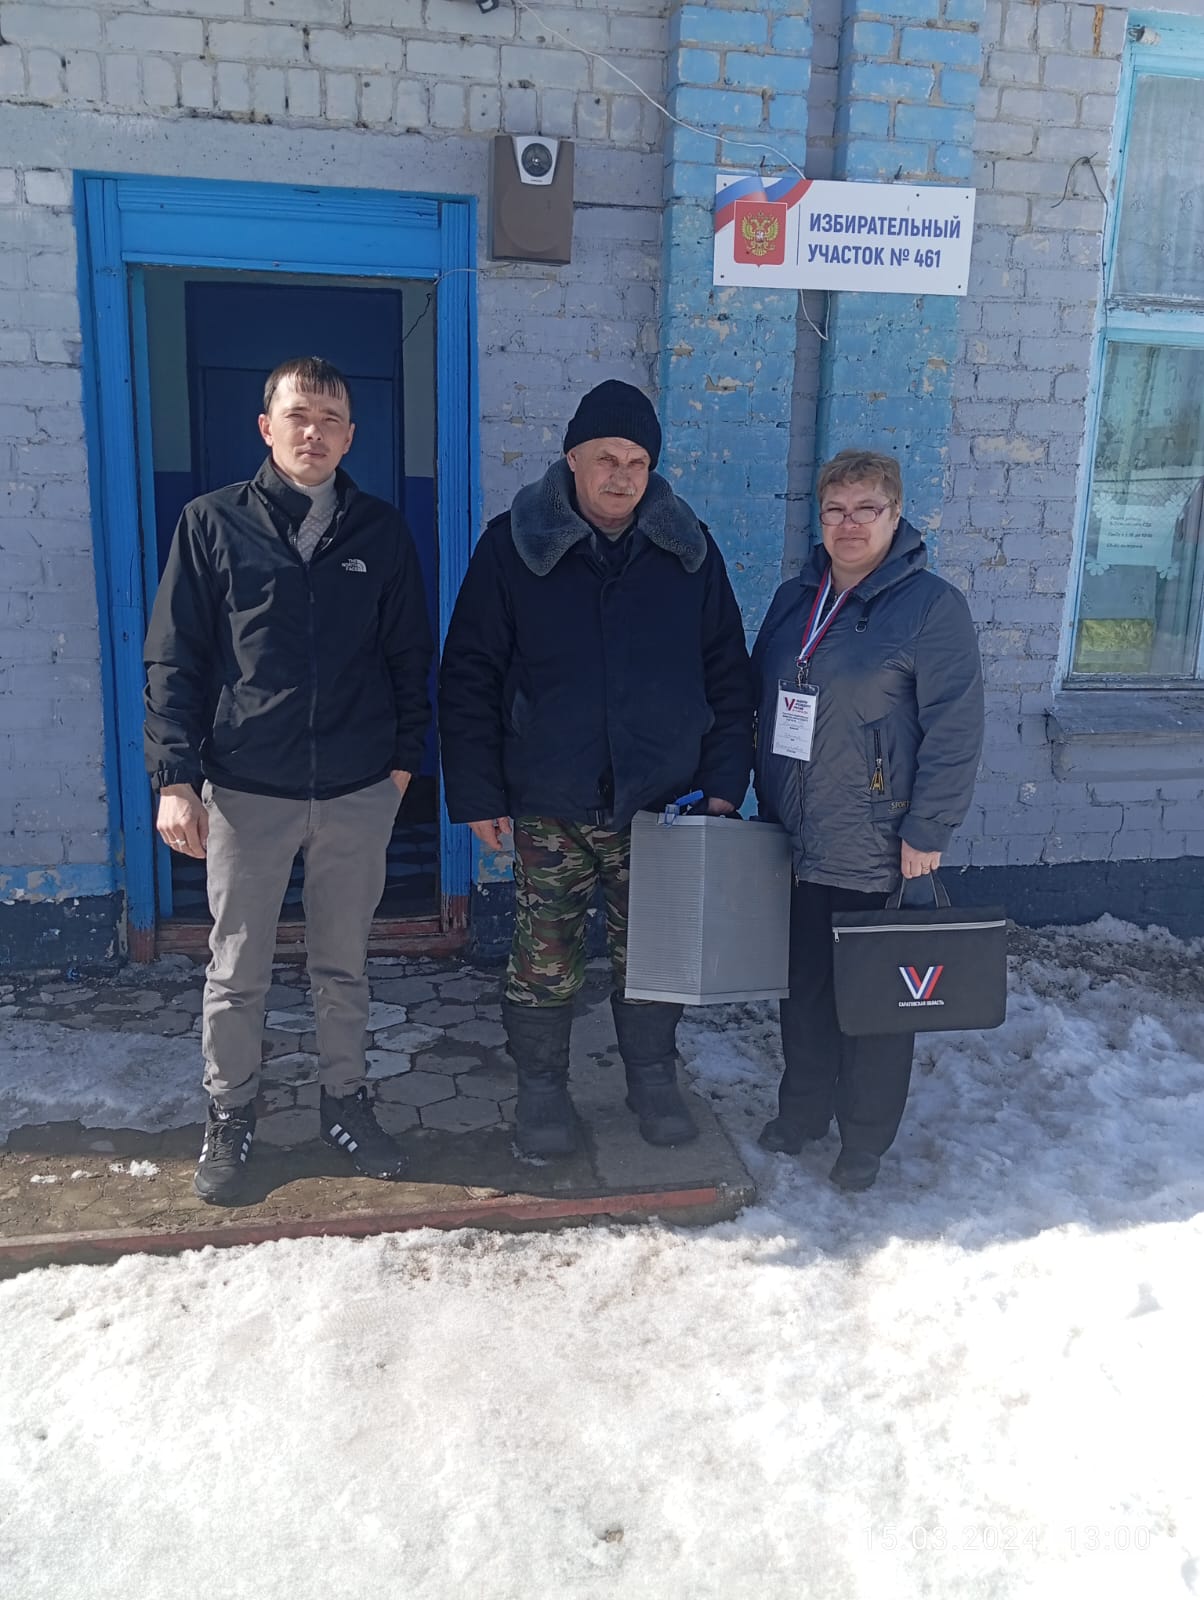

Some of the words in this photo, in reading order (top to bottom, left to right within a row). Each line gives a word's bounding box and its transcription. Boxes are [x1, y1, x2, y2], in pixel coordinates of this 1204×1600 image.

[809, 212, 961, 239] ИЗБИРАТЕЛЬНЫЙ
[807, 243, 885, 266] УЧАСТОК
[889, 247, 910, 267] №
[914, 249, 941, 268] 461
